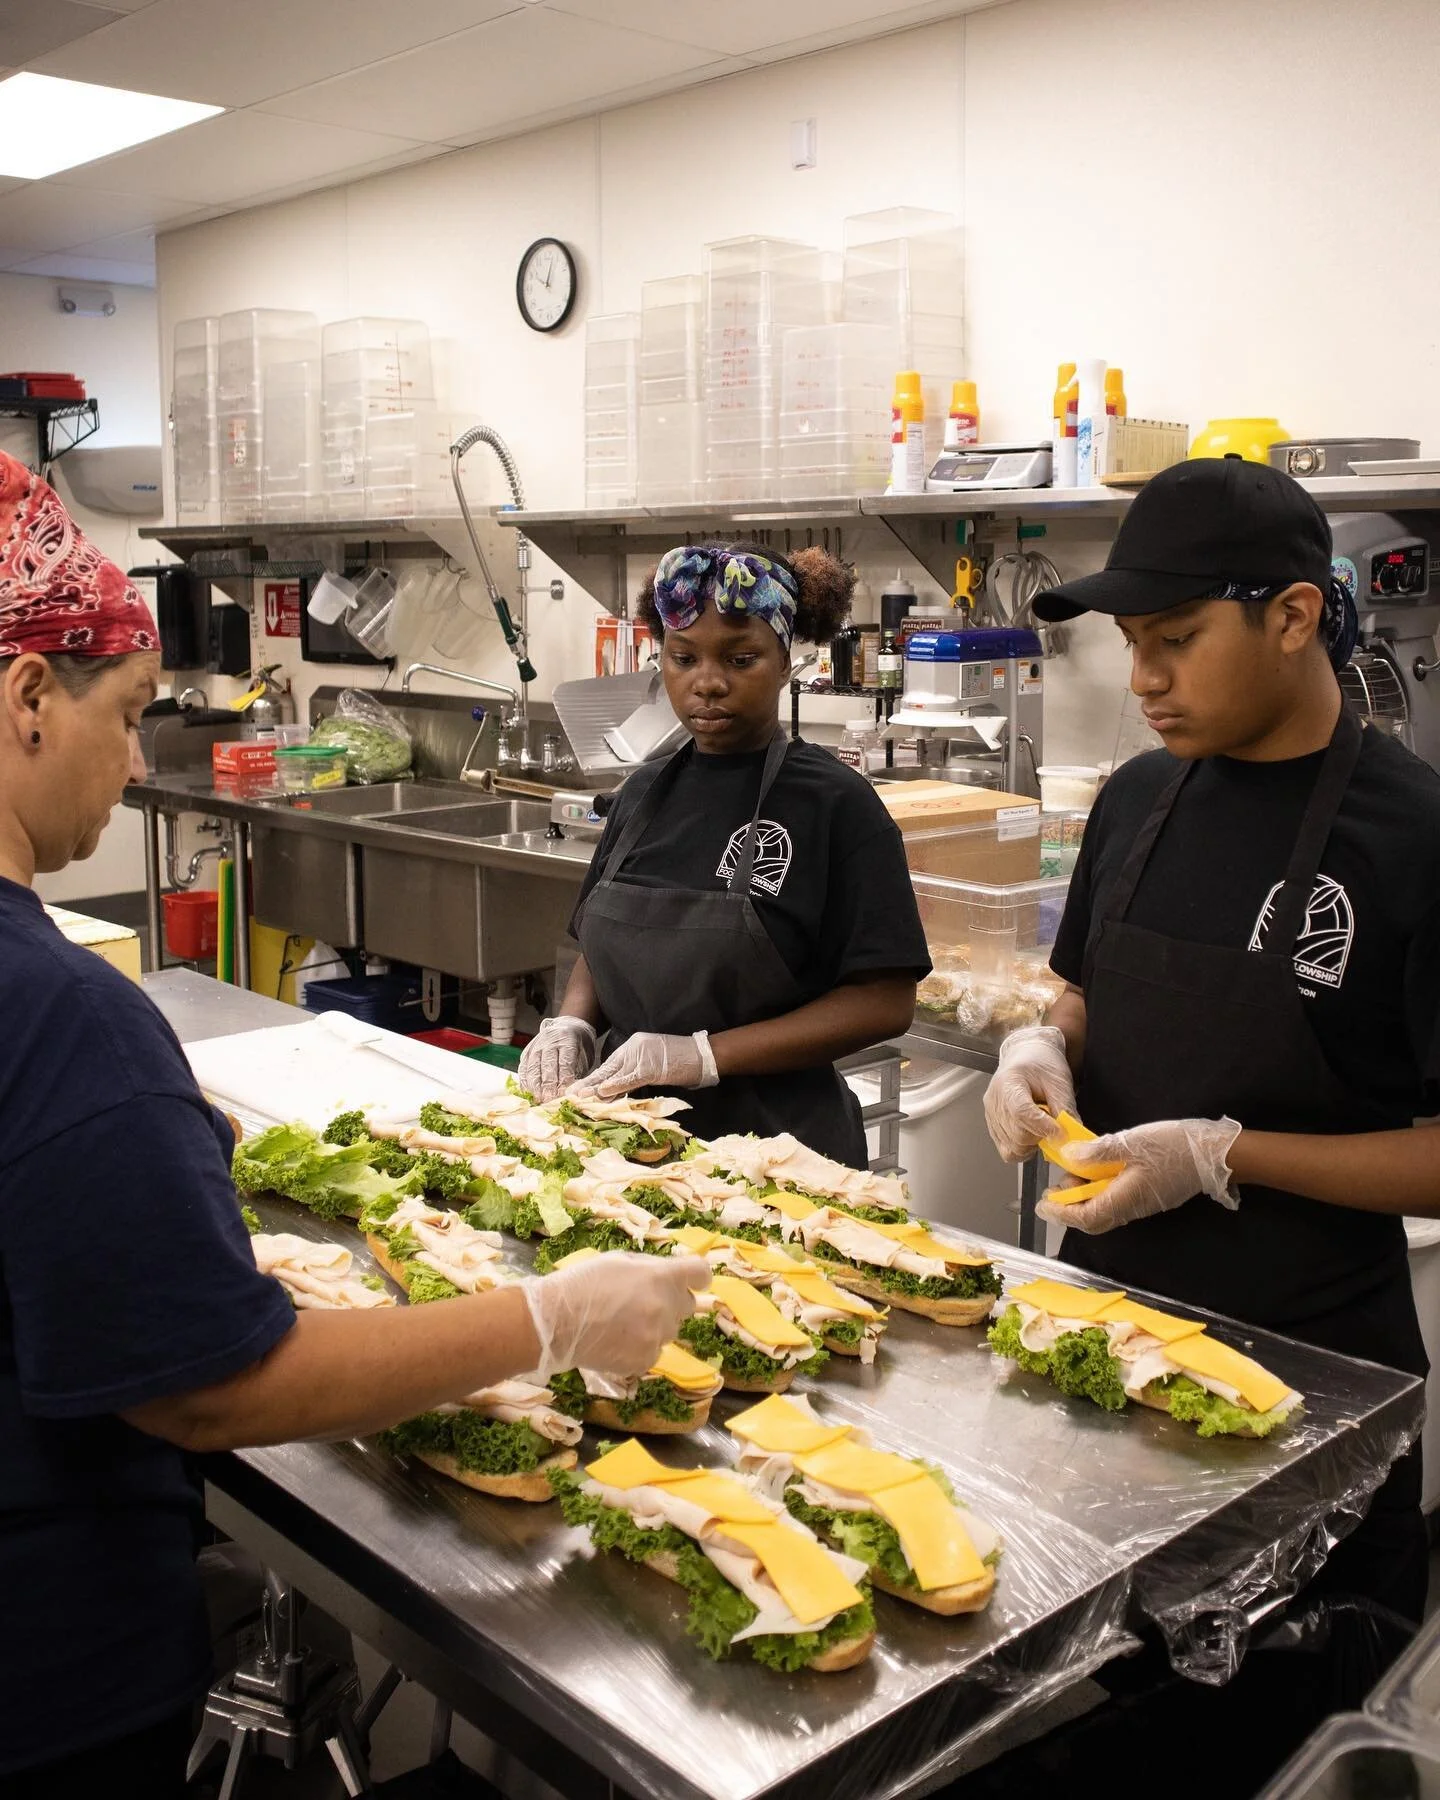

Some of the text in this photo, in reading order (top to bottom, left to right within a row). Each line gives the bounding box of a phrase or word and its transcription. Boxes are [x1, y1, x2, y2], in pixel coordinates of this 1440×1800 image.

[719, 868, 778, 892] FOO OWSHIP
[1294, 962, 1338, 982] LOWSHIP
